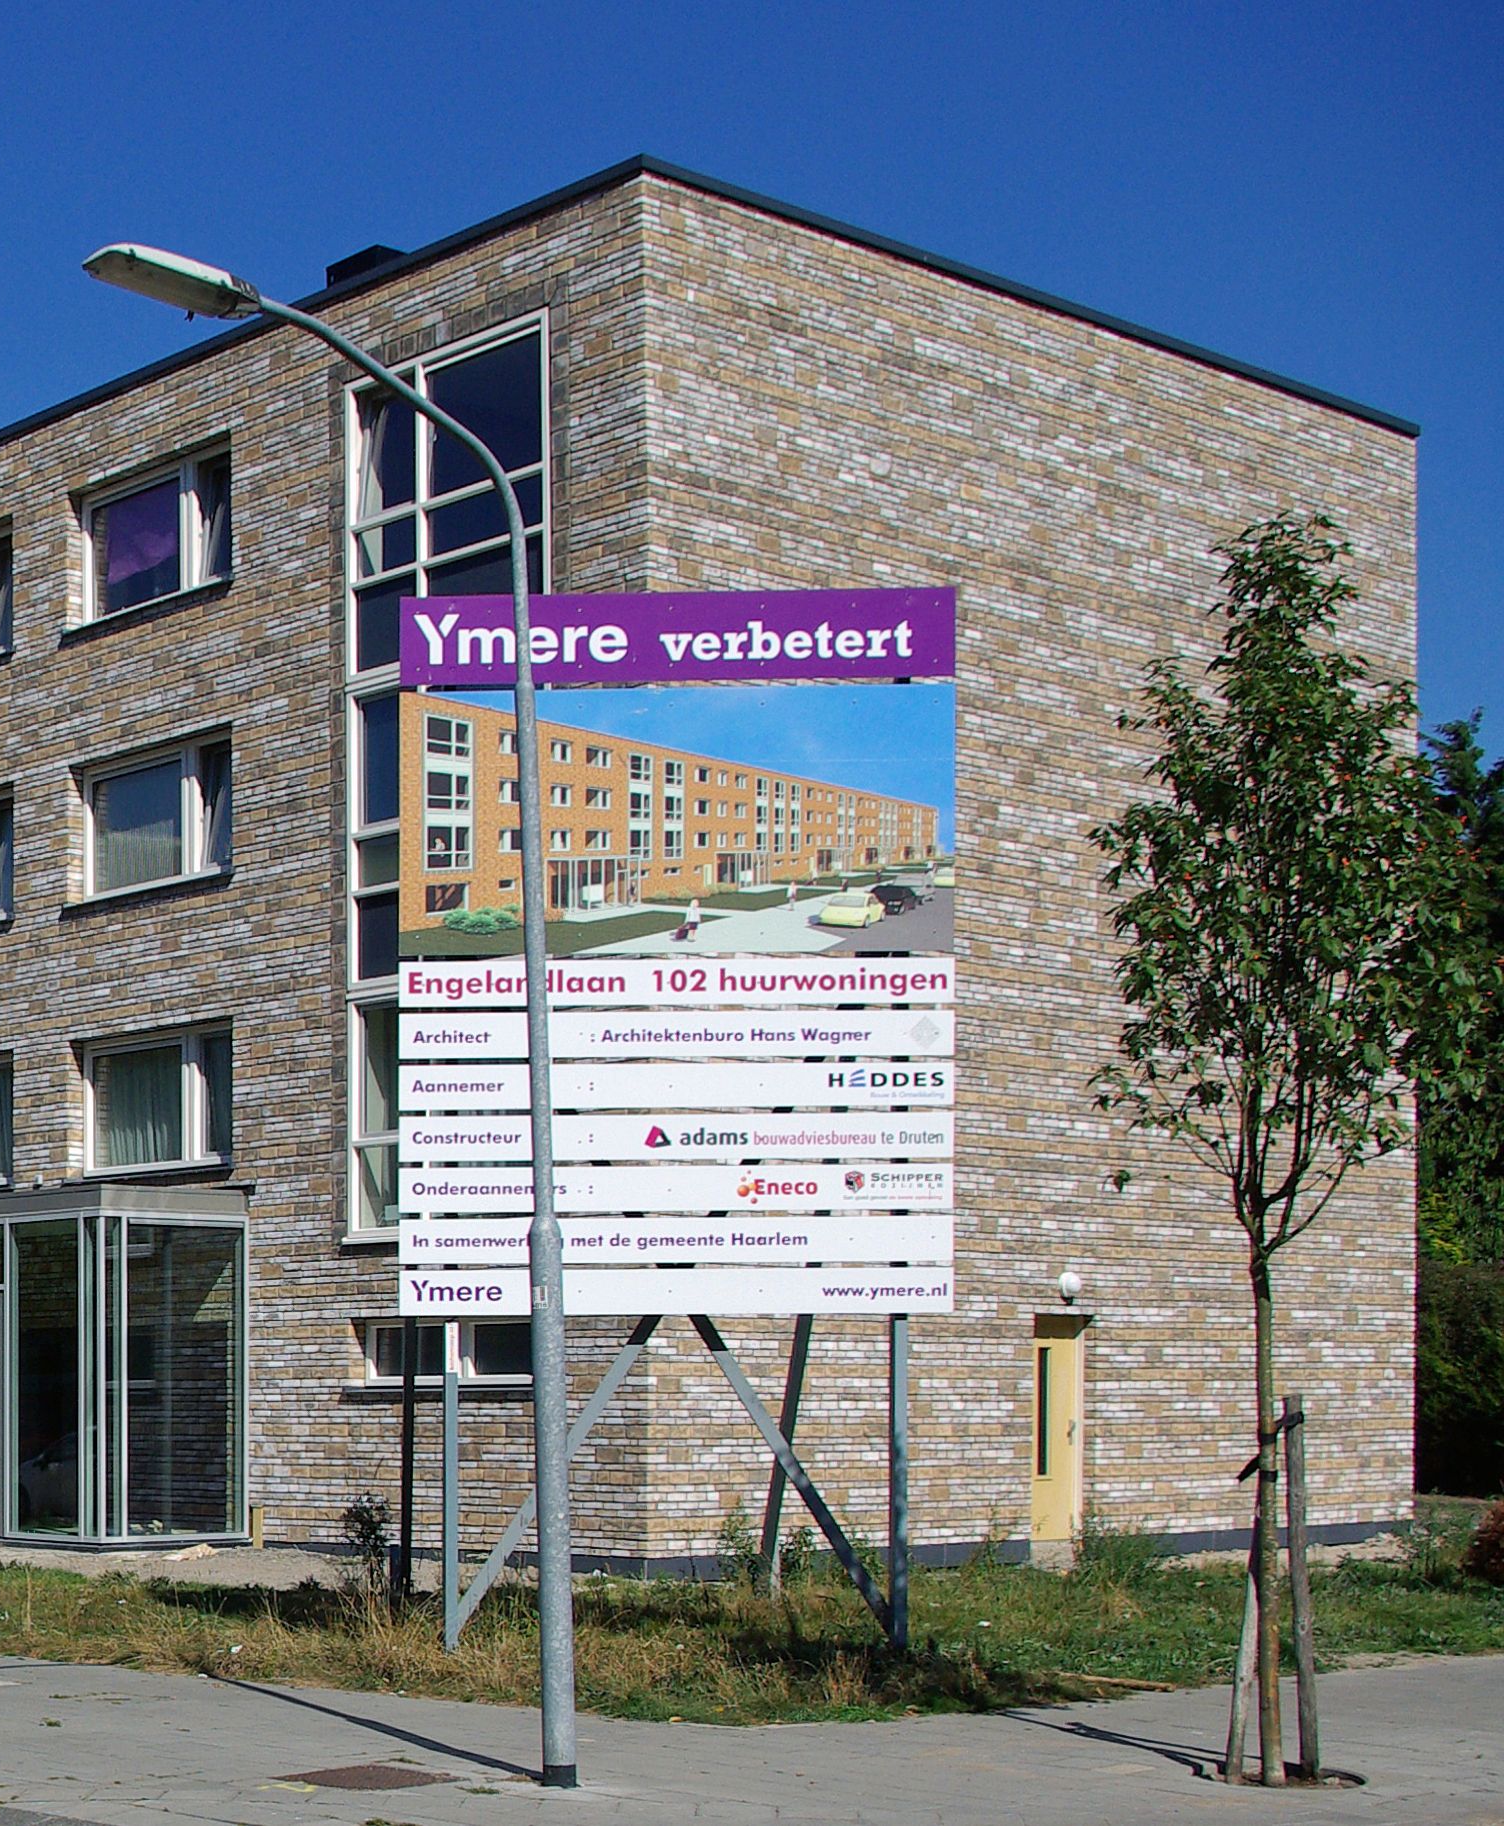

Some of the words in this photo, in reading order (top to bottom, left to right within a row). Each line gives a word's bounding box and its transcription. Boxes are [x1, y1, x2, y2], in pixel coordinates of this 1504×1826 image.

[413, 612, 628, 665] Ymere
[659, 619, 913, 662] verbetert
[652, 968, 707, 993] 102
[719, 967, 948, 996] huurwoningen
[413, 1030, 492, 1044] Architect
[601, 1027, 745, 1043] Architektenburo
[750, 1027, 796, 1042] Hans
[801, 1027, 872, 1044] Wagner
[412, 1079, 505, 1093] Aannemer
[412, 1131, 522, 1144] Constructeur
[679, 1127, 748, 1146] adams
[753, 1130, 876, 1146] bouwadviesbureau
[881, 1132, 894, 1145] te
[899, 1130, 944, 1145] Druten
[412, 1182, 567, 1195] Onderaannemrs
[753, 1178, 818, 1195] Eneco
[413, 1235, 428, 1247] In
[571, 1234, 603, 1247] met
[609, 1233, 630, 1247] de
[637, 1233, 725, 1250] gemeente
[731, 1232, 808, 1246] Haarlem
[410, 1279, 503, 1302] Ymere
[822, 1283, 948, 1300] www.ymere.nl
